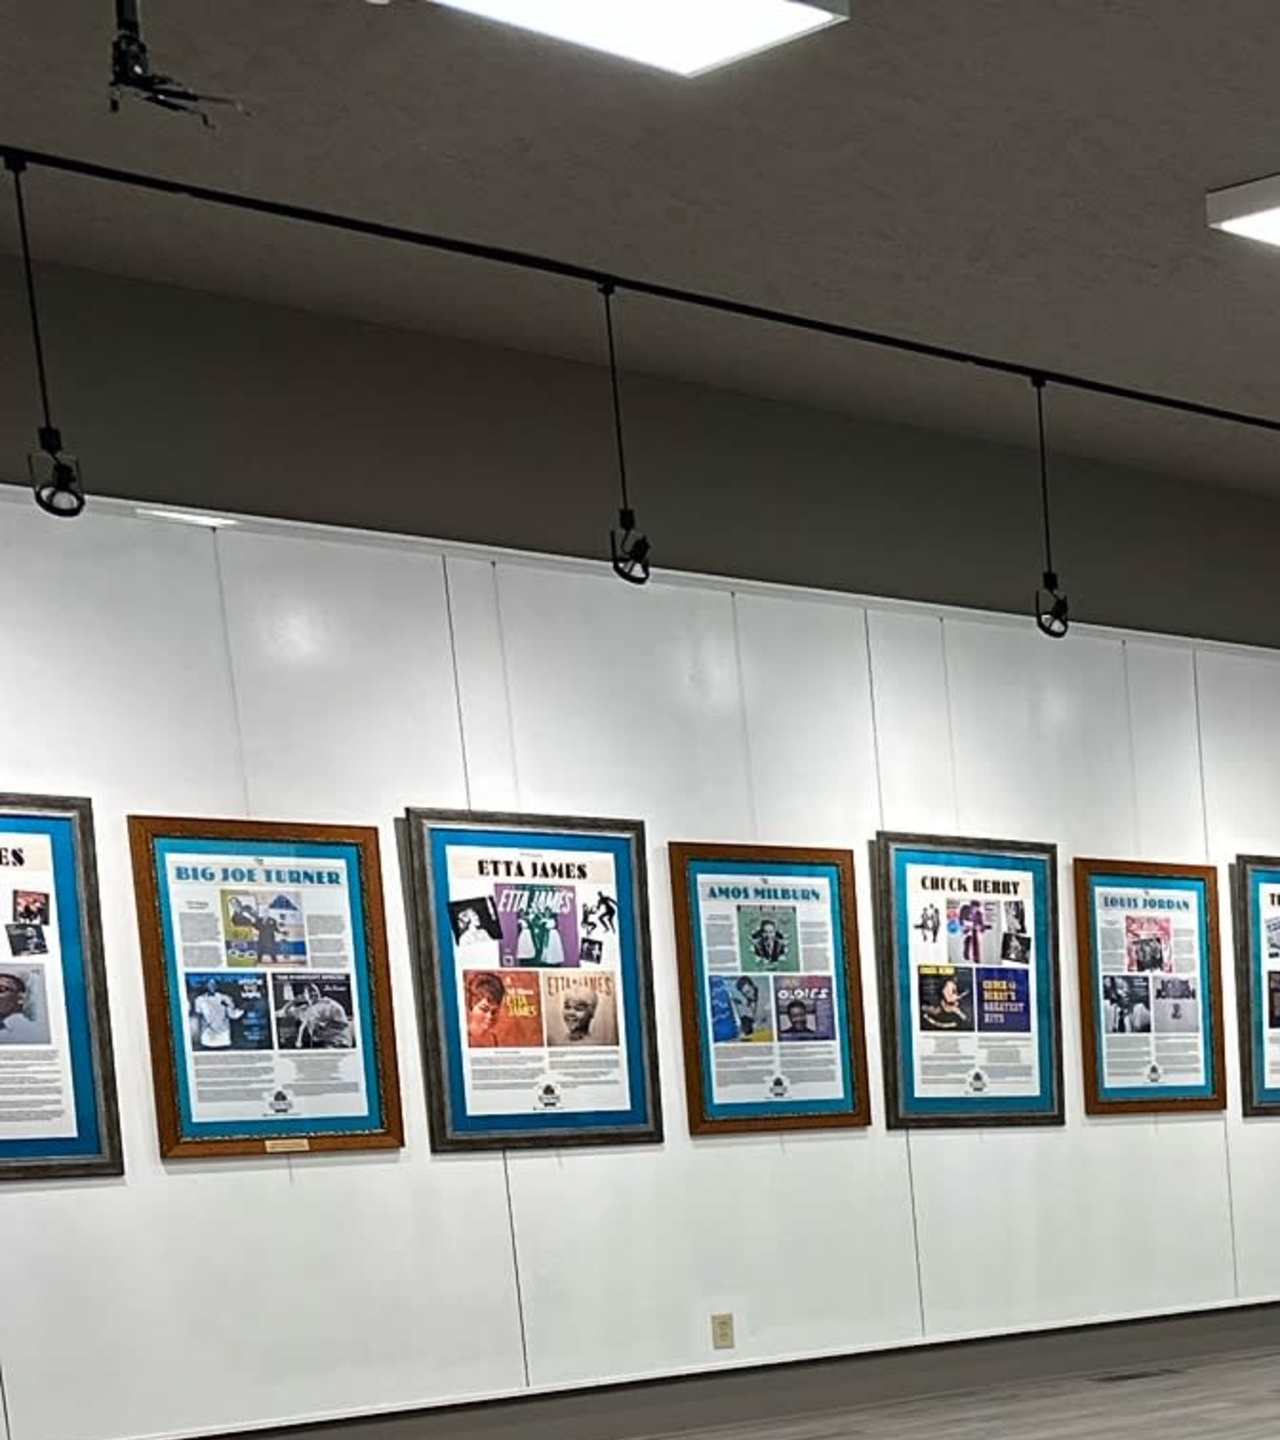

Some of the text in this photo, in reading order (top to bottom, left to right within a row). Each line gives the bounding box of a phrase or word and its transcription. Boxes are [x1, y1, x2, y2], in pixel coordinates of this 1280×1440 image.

[175, 866, 341, 885] BIG JOE TURNER
[478, 860, 587, 879] ETTA JAMES
[708, 885, 820, 901] AMOS MILBURN
[921, 875, 1020, 895] CHUCK BERRY
[498, 889, 574, 914] ETTA JAMES
[1103, 895, 1189, 911] LOUIS JORDAN
